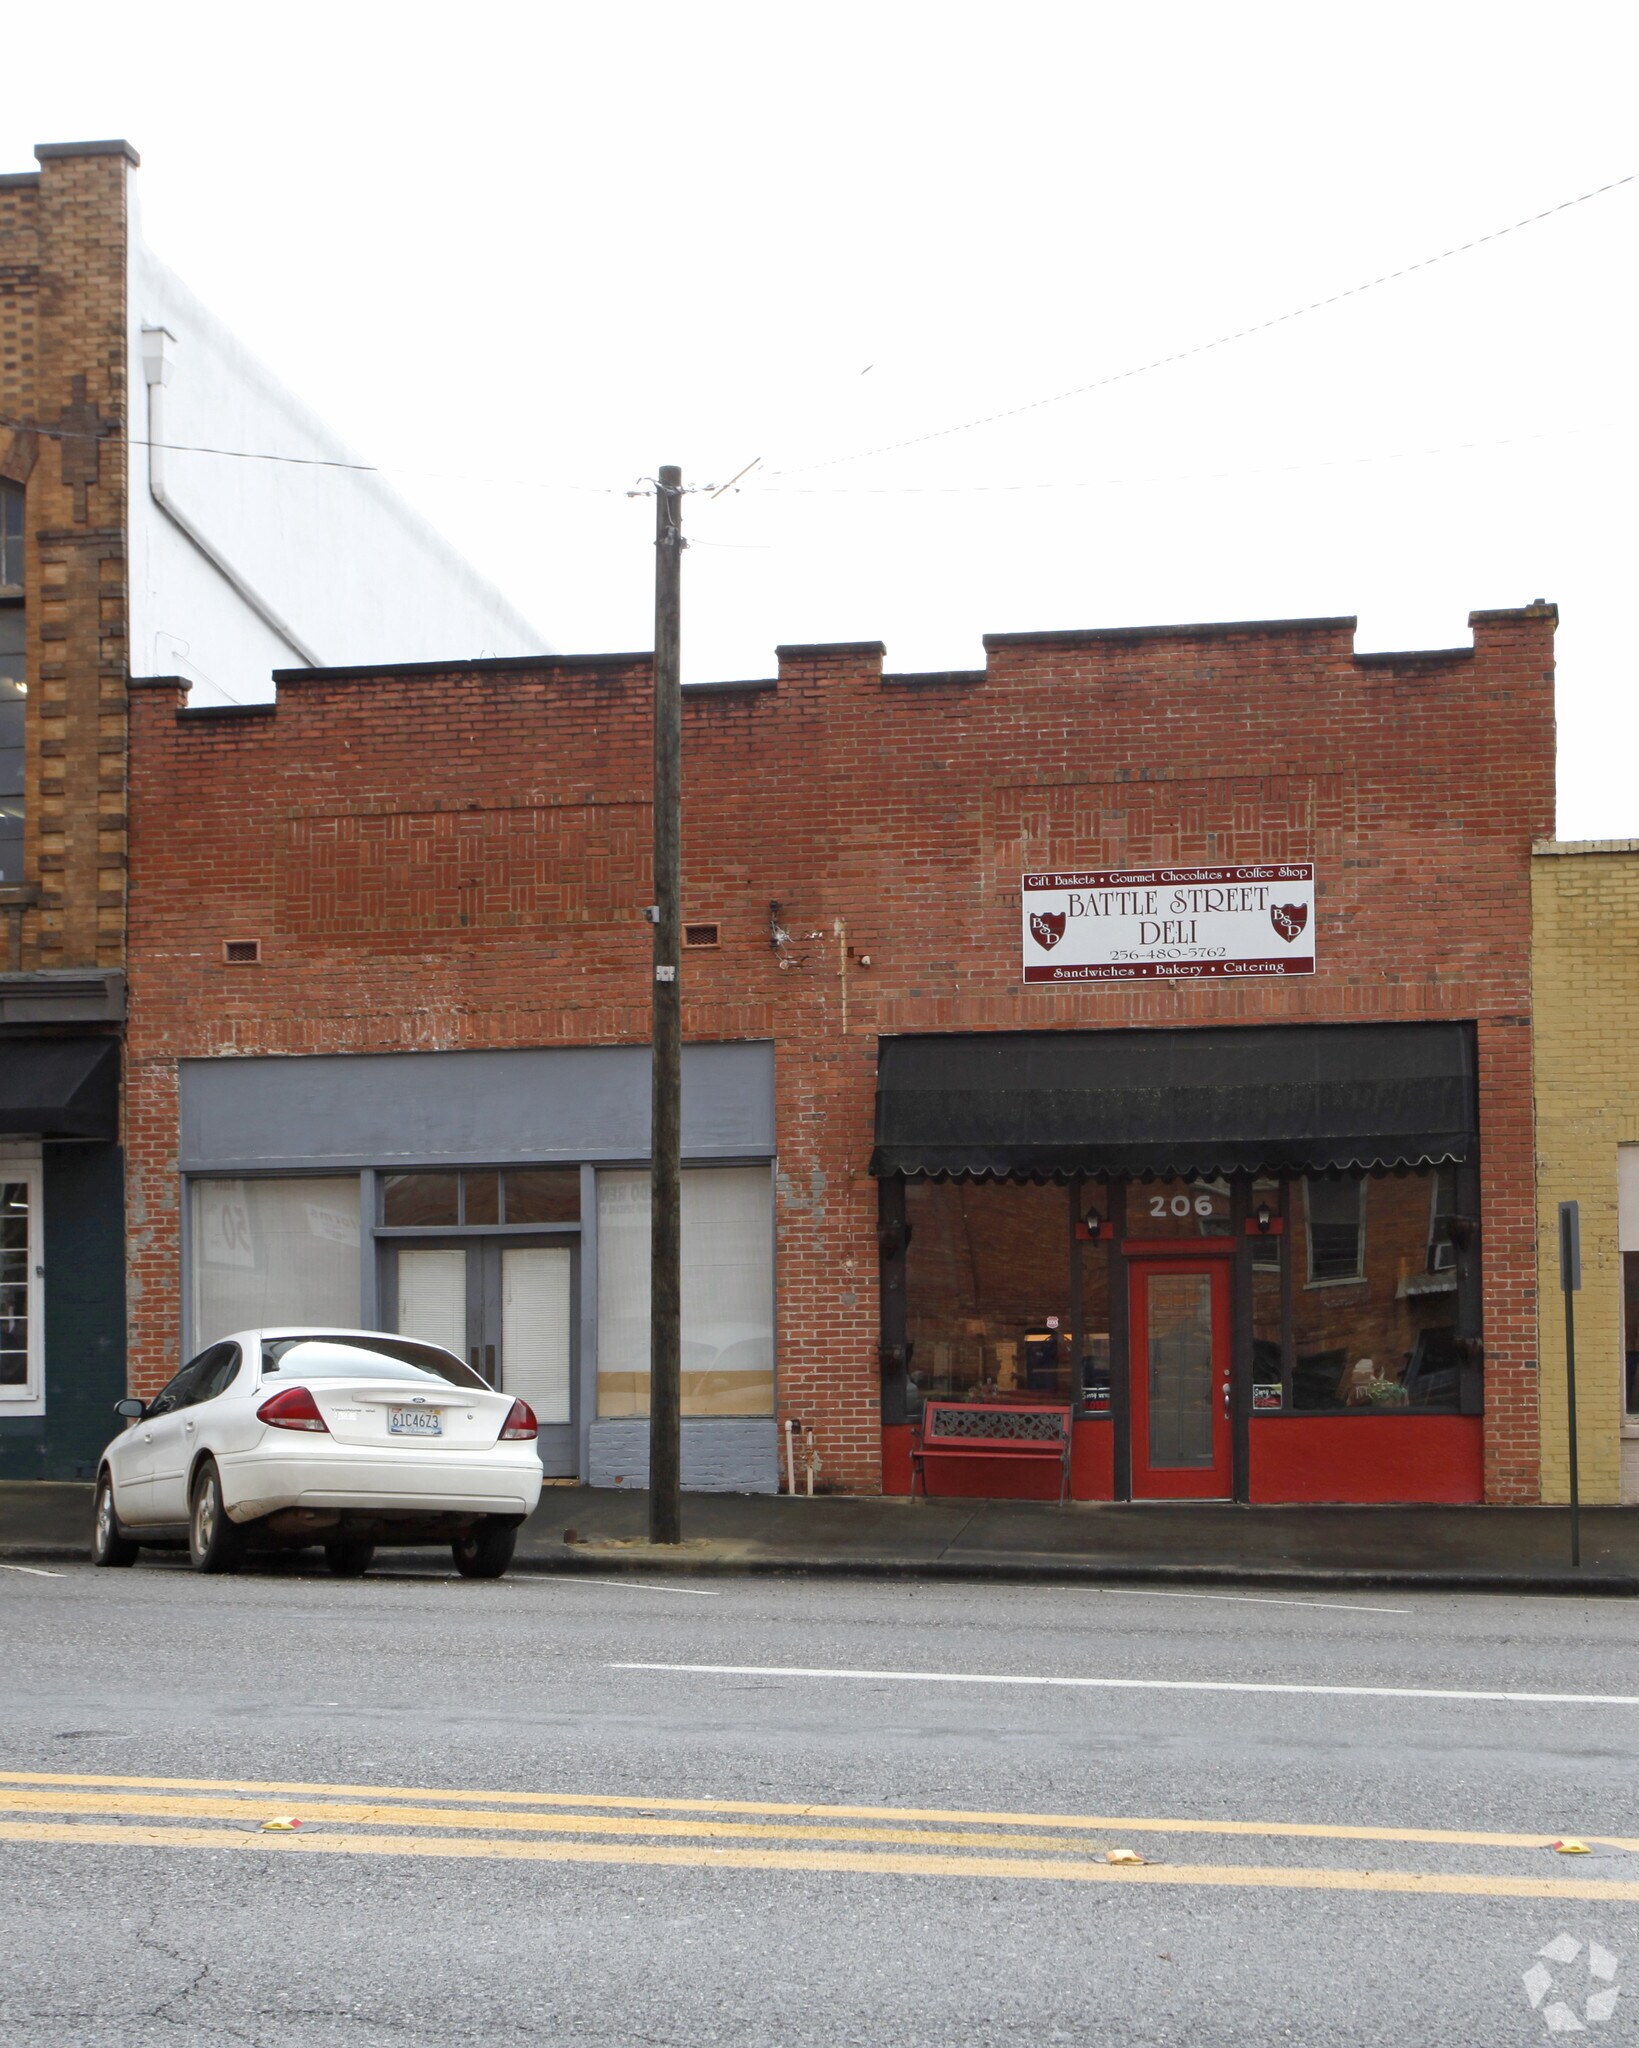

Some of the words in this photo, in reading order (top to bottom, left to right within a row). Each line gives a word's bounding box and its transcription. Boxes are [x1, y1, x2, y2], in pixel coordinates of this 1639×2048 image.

[1028, 875, 1051, 887] Gift
[1054, 874, 1096, 886] Baskets
[1108, 871, 1157, 884] Gourmet
[1160, 869, 1223, 882] Chocolates
[1236, 867, 1275, 880] Coffee
[1278, 866, 1308, 881] Shop
[1067, 890, 1158, 918] BATTLE
[1169, 885, 1270, 915] STREET
[1138, 919, 1198, 946] DELI
[1109, 946, 1227, 961] 256-480-5762
[1053, 966, 1135, 979] Sandwiches
[1155, 963, 1203, 977] Bakery
[1223, 961, 1285, 975] Catering
[1149, 1195, 1213, 1217] 206
[392, 1413, 439, 1428] 61C46Z3
